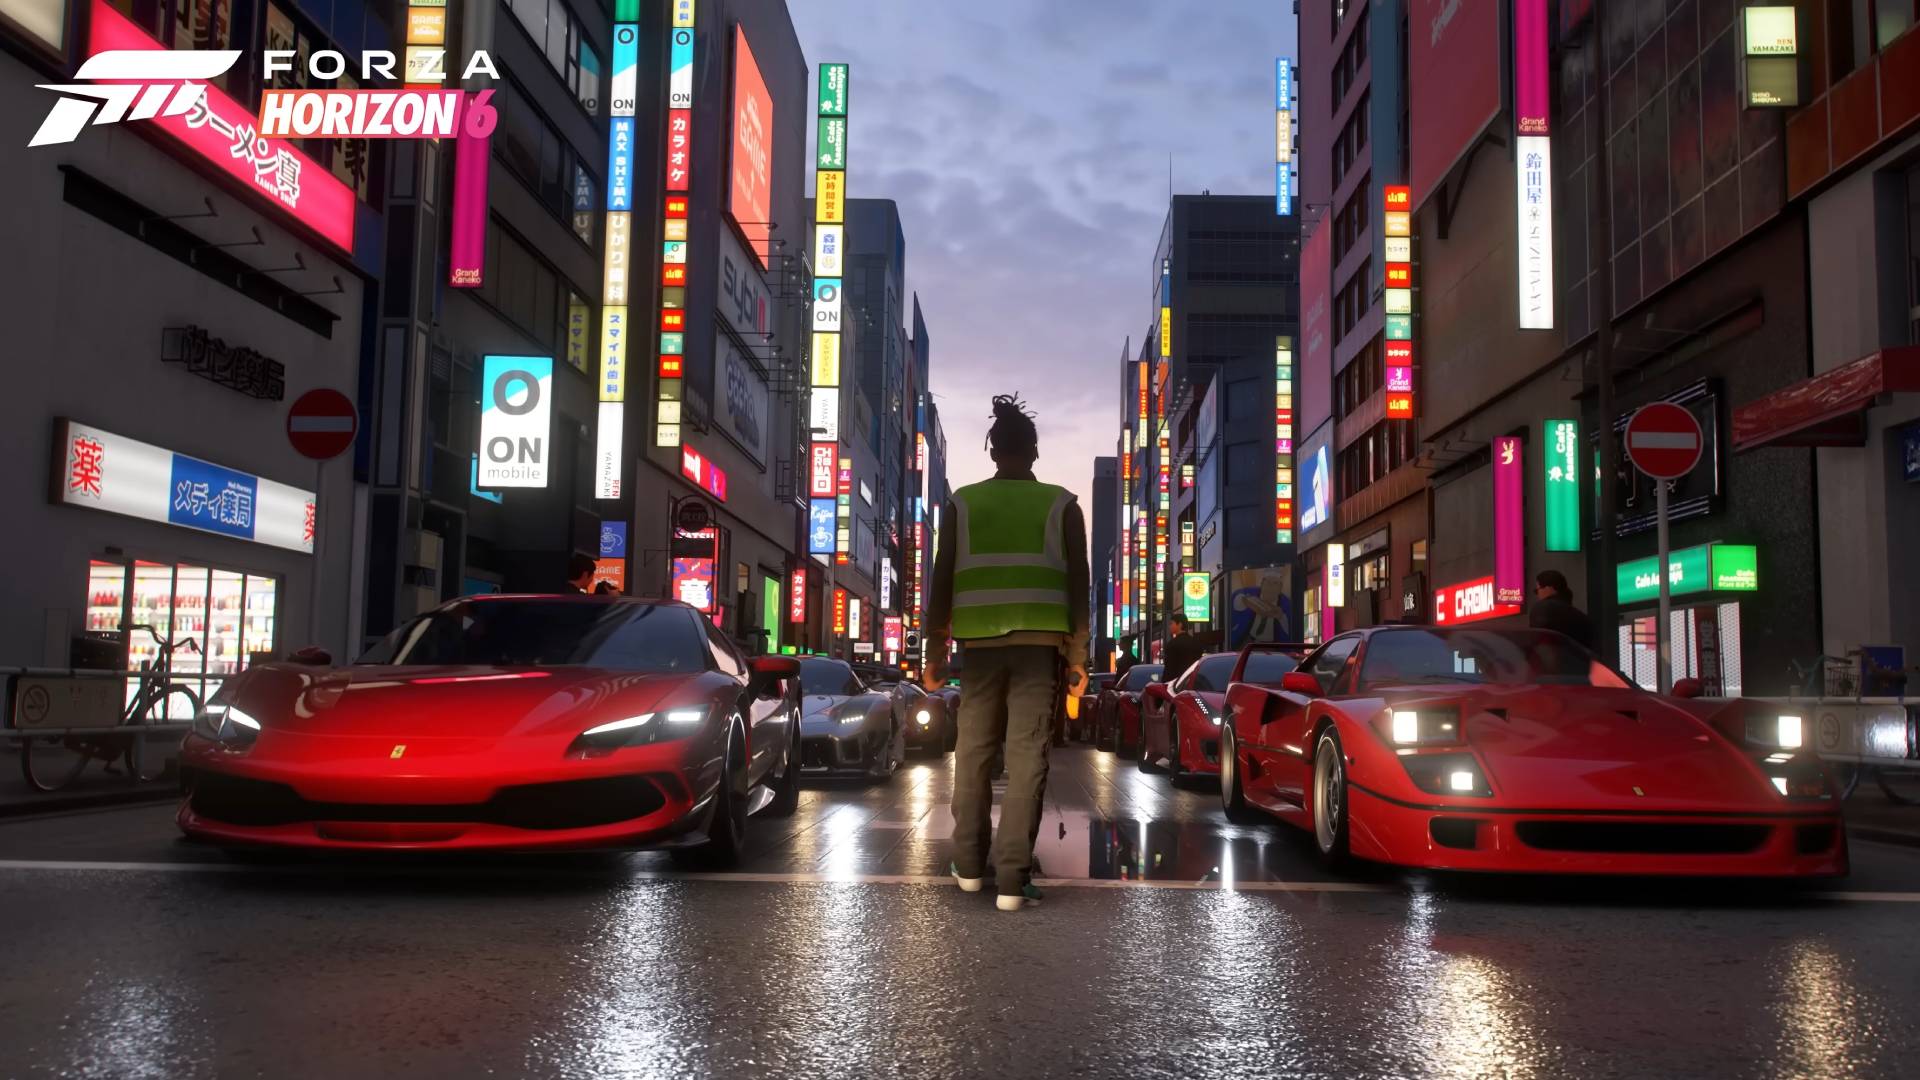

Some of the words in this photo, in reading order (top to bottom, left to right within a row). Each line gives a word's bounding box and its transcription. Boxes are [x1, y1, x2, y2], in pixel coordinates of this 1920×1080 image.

[827, 67, 837, 90] Cafe
[613, 99, 635, 110] ON
[672, 94, 691, 103] ON
[1518, 125, 1548, 133] Kaneko
[1520, 117, 1546, 126] Grand
[614, 122, 629, 152] MAX
[671, 118, 686, 182] カラオケ
[612, 156, 628, 207] SHIMA
[1526, 152, 1543, 205] 鈴田屋
[452, 276, 482, 284] Kaneko
[455, 268, 481, 277] Grand
[816, 311, 838, 322] ON
[493, 369, 541, 416] O
[487, 436, 542, 465] ON
[1555, 423, 1566, 454] Cafe
[69, 436, 104, 500] 薬
[487, 465, 541, 480] mobile
[174, 481, 251, 529] メディ薬局
[793, 576, 803, 617] カラオケ
[1455, 583, 1494, 618] CHROMA
[1497, 594, 1523, 603] Kaneko
[1499, 588, 1521, 596] Grand
